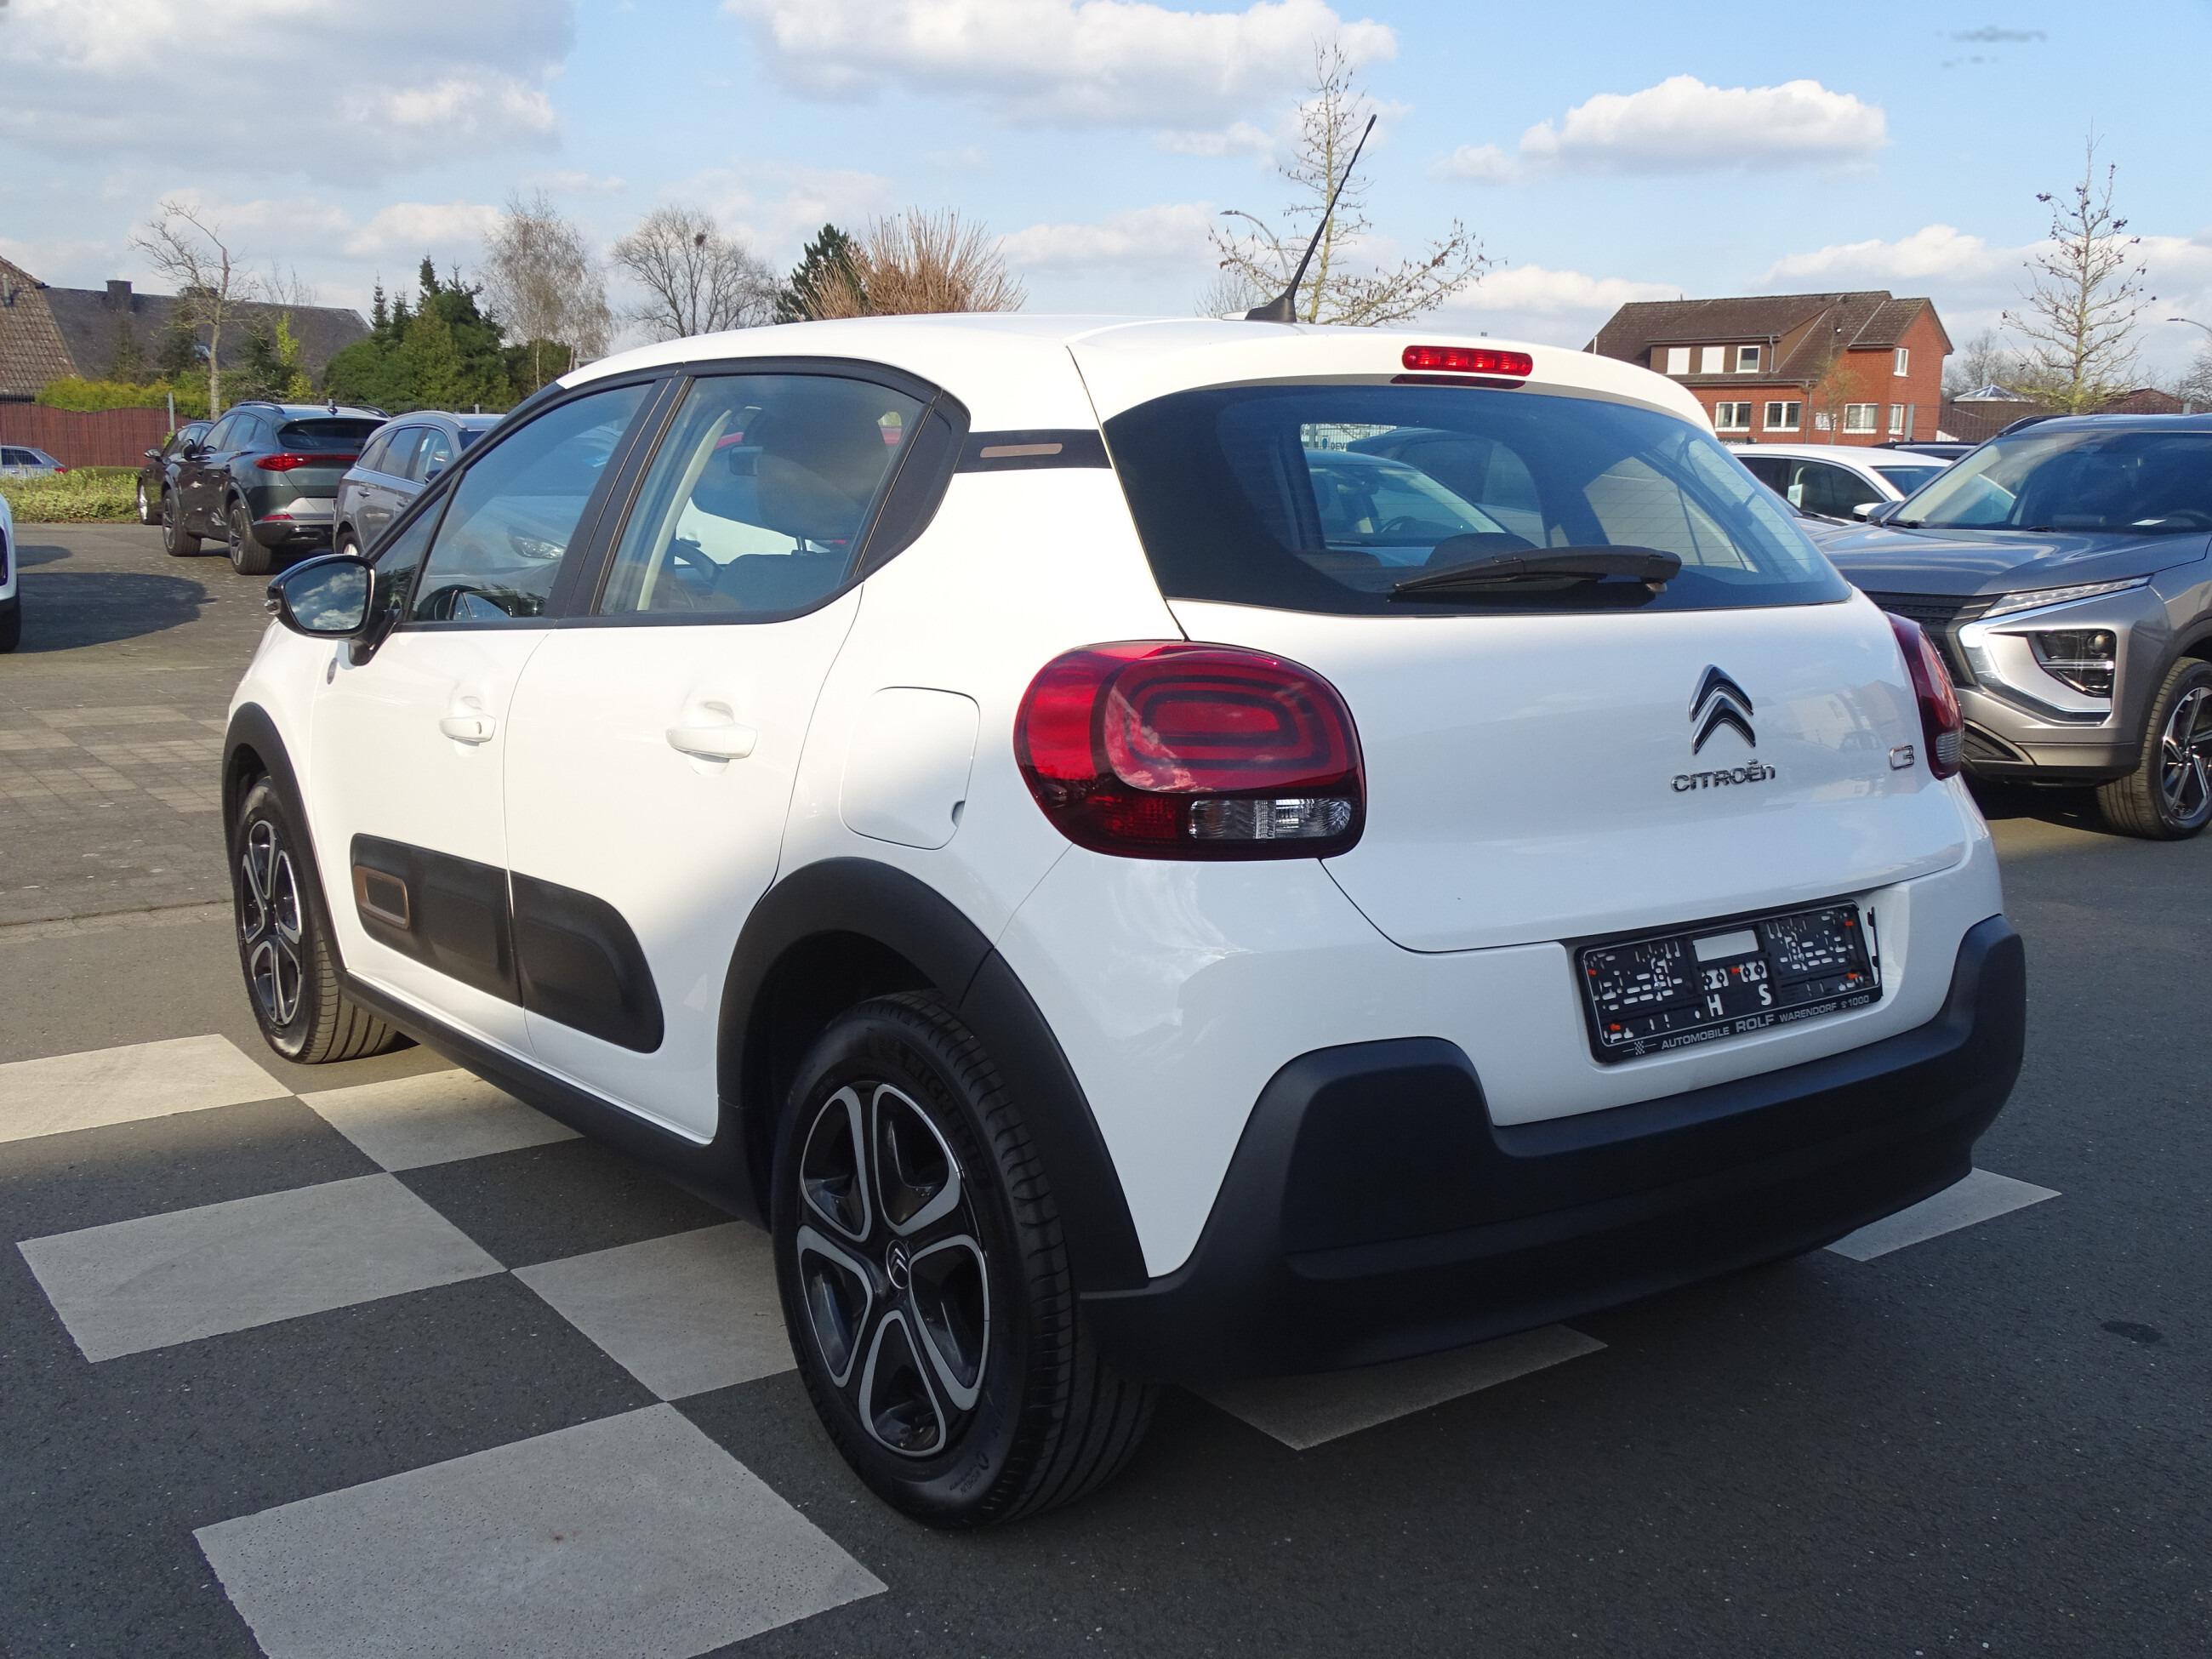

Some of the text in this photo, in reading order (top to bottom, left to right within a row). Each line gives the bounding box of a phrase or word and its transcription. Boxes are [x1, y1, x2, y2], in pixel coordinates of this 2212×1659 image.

[1889, 744, 1914, 770] C3
[1661, 1026, 1730, 1050] AUTOMOBILE
[1736, 1013, 1775, 1034] ROLF
[1779, 1002, 1838, 1023] WARENDORF
